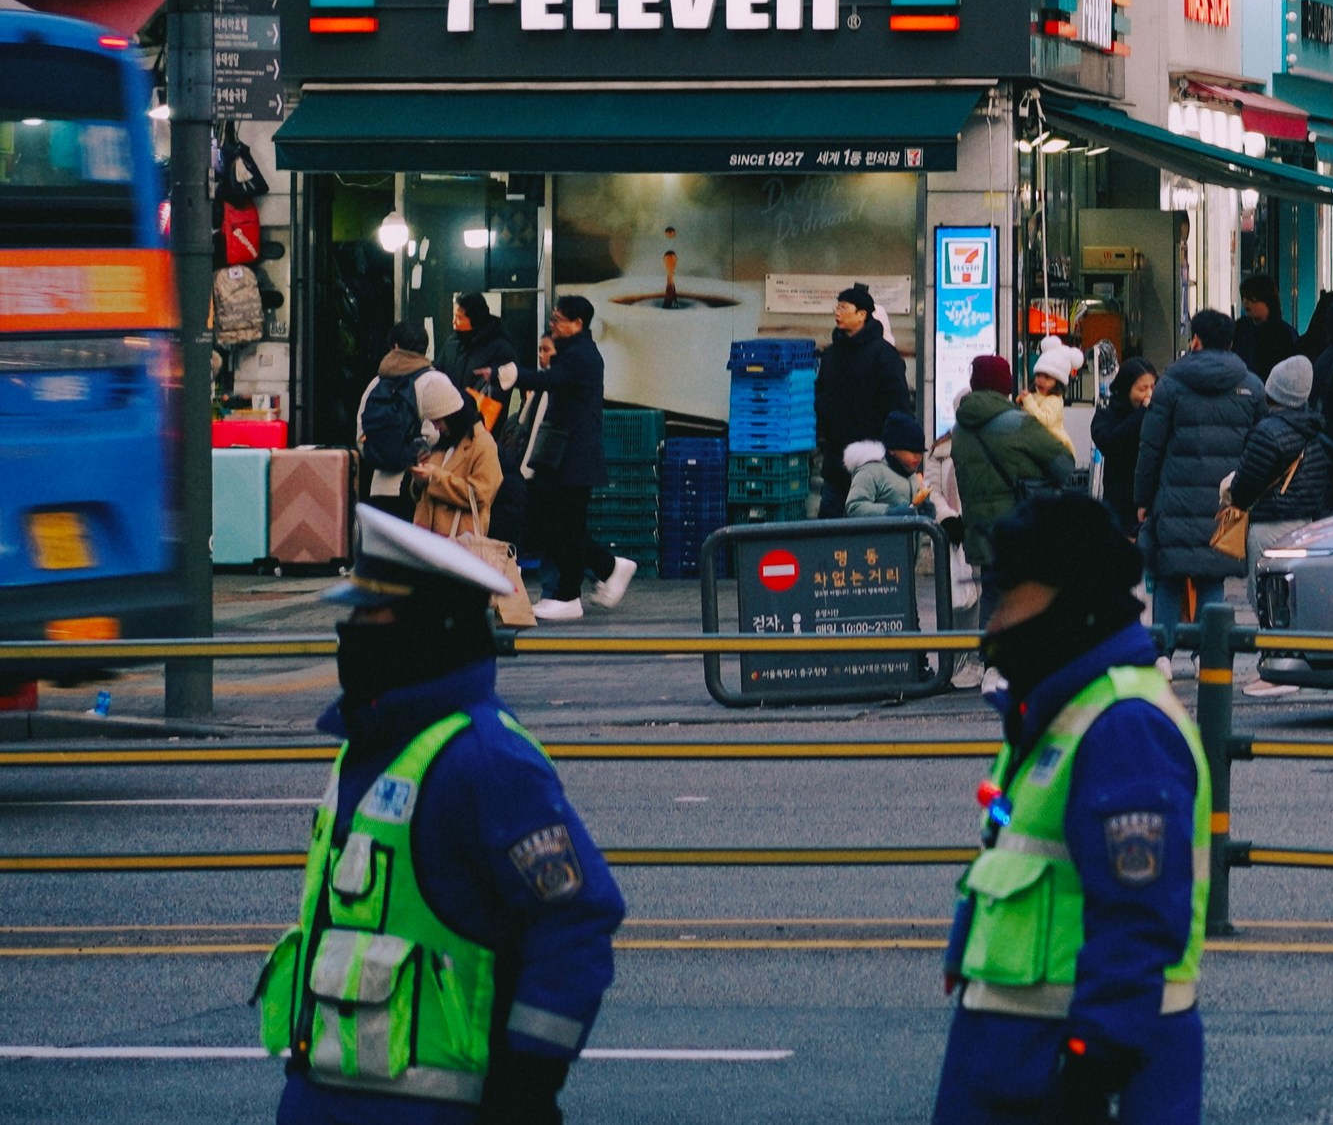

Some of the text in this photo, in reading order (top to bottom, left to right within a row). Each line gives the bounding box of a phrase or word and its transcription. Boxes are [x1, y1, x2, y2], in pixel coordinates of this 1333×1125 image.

[729, 149, 900, 166] SINCE 1927 세계 1등 편의점
[762, 669, 797, 680] 서울특별시
